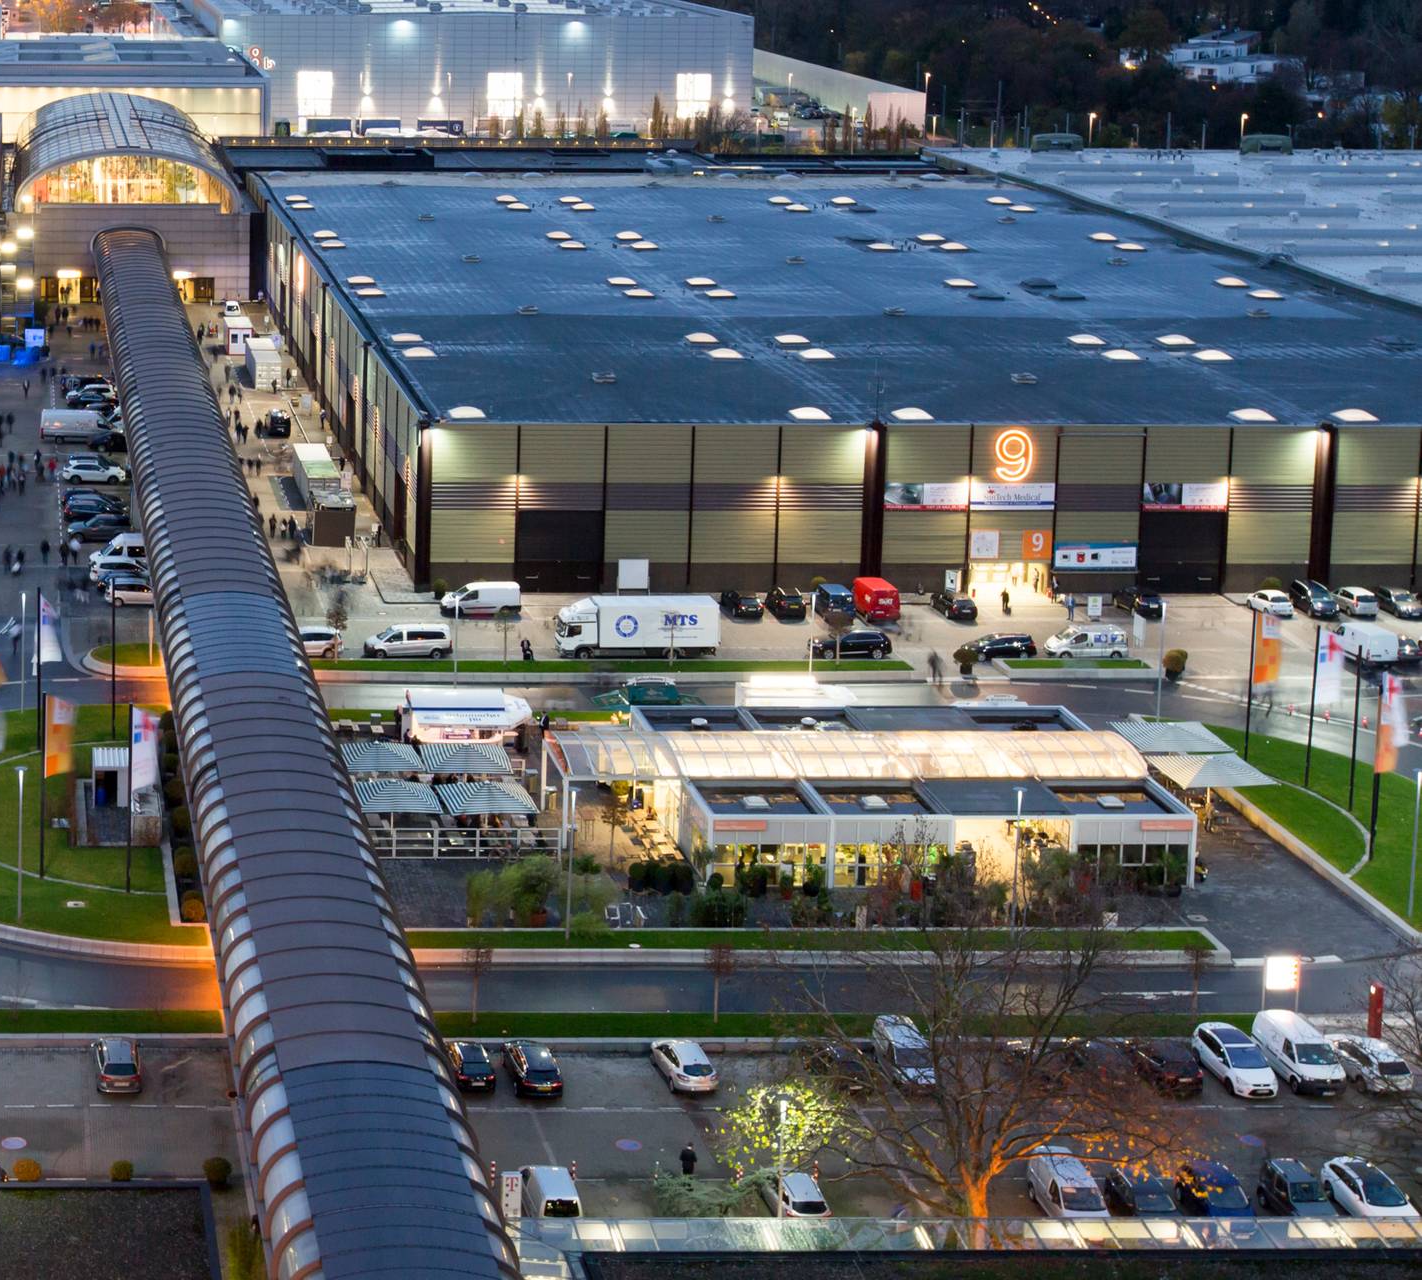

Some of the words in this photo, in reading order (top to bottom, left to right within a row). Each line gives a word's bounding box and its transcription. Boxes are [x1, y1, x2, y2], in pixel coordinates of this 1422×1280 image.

[993, 429, 1035, 483] 9
[1013, 492, 1042, 501] Medical
[1032, 532, 1044, 552] 9
[663, 614, 699, 626] MTS
[505, 1176, 519, 1192] T
